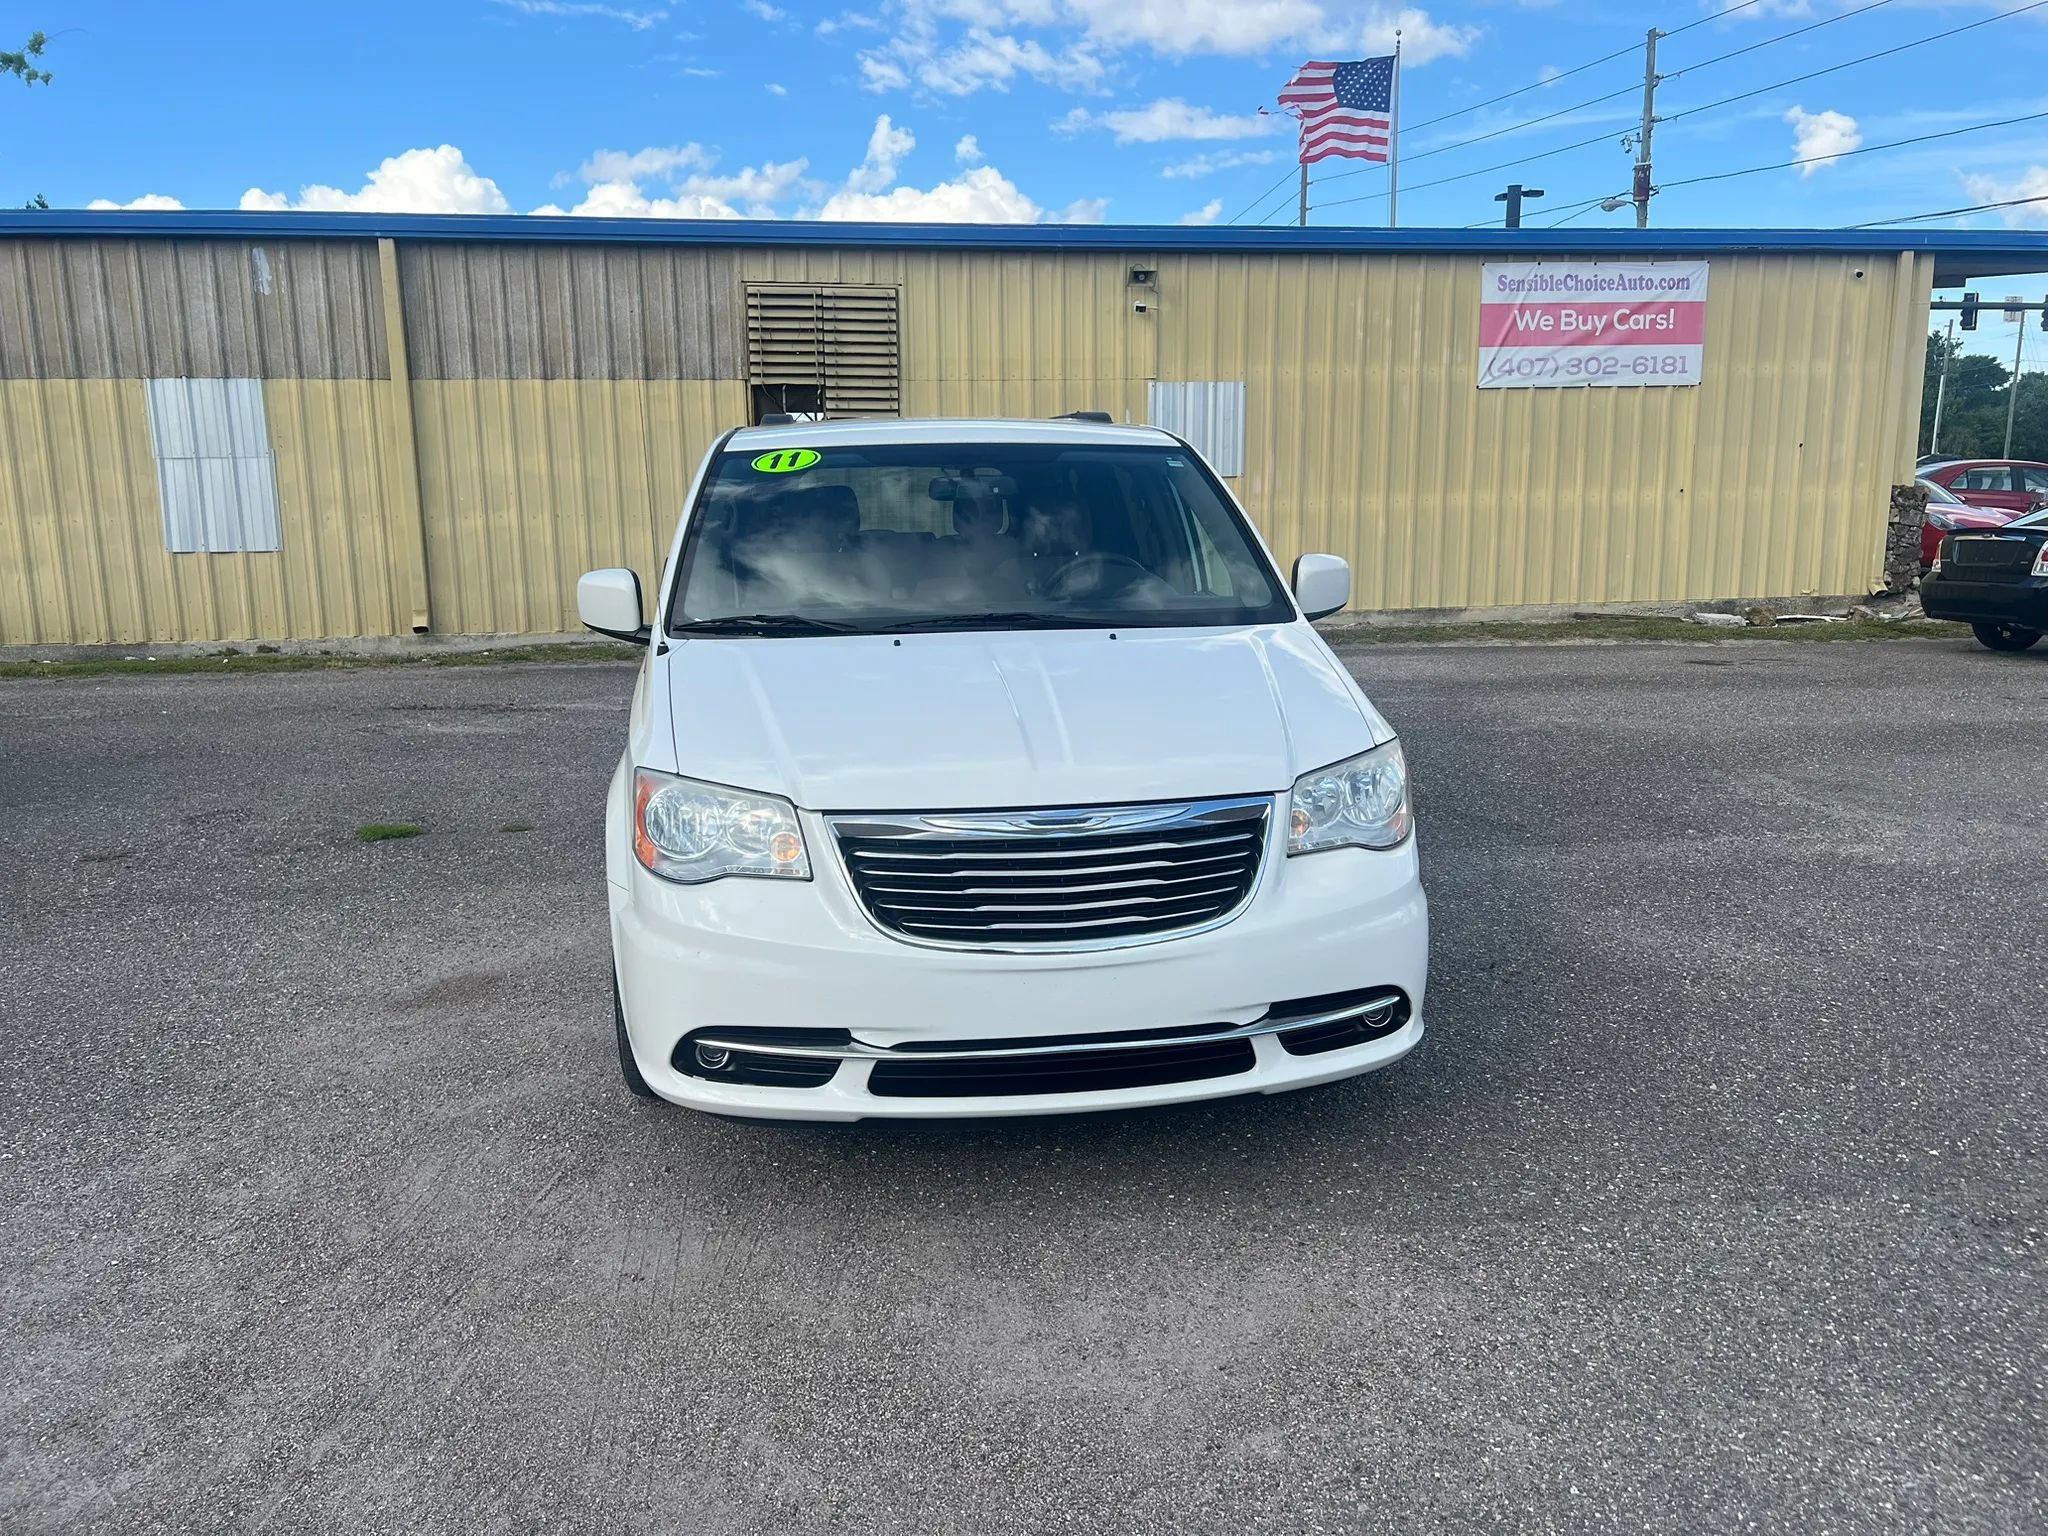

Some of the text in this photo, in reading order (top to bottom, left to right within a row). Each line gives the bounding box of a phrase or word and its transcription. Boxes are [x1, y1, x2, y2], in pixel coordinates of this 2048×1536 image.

[1497, 273, 1691, 292] SensibleChoiceAuto.com
[1514, 308, 1675, 336] We Buy Cars!
[1488, 355, 1688, 379] (407) 302-6181
[769, 451, 802, 469] 11
